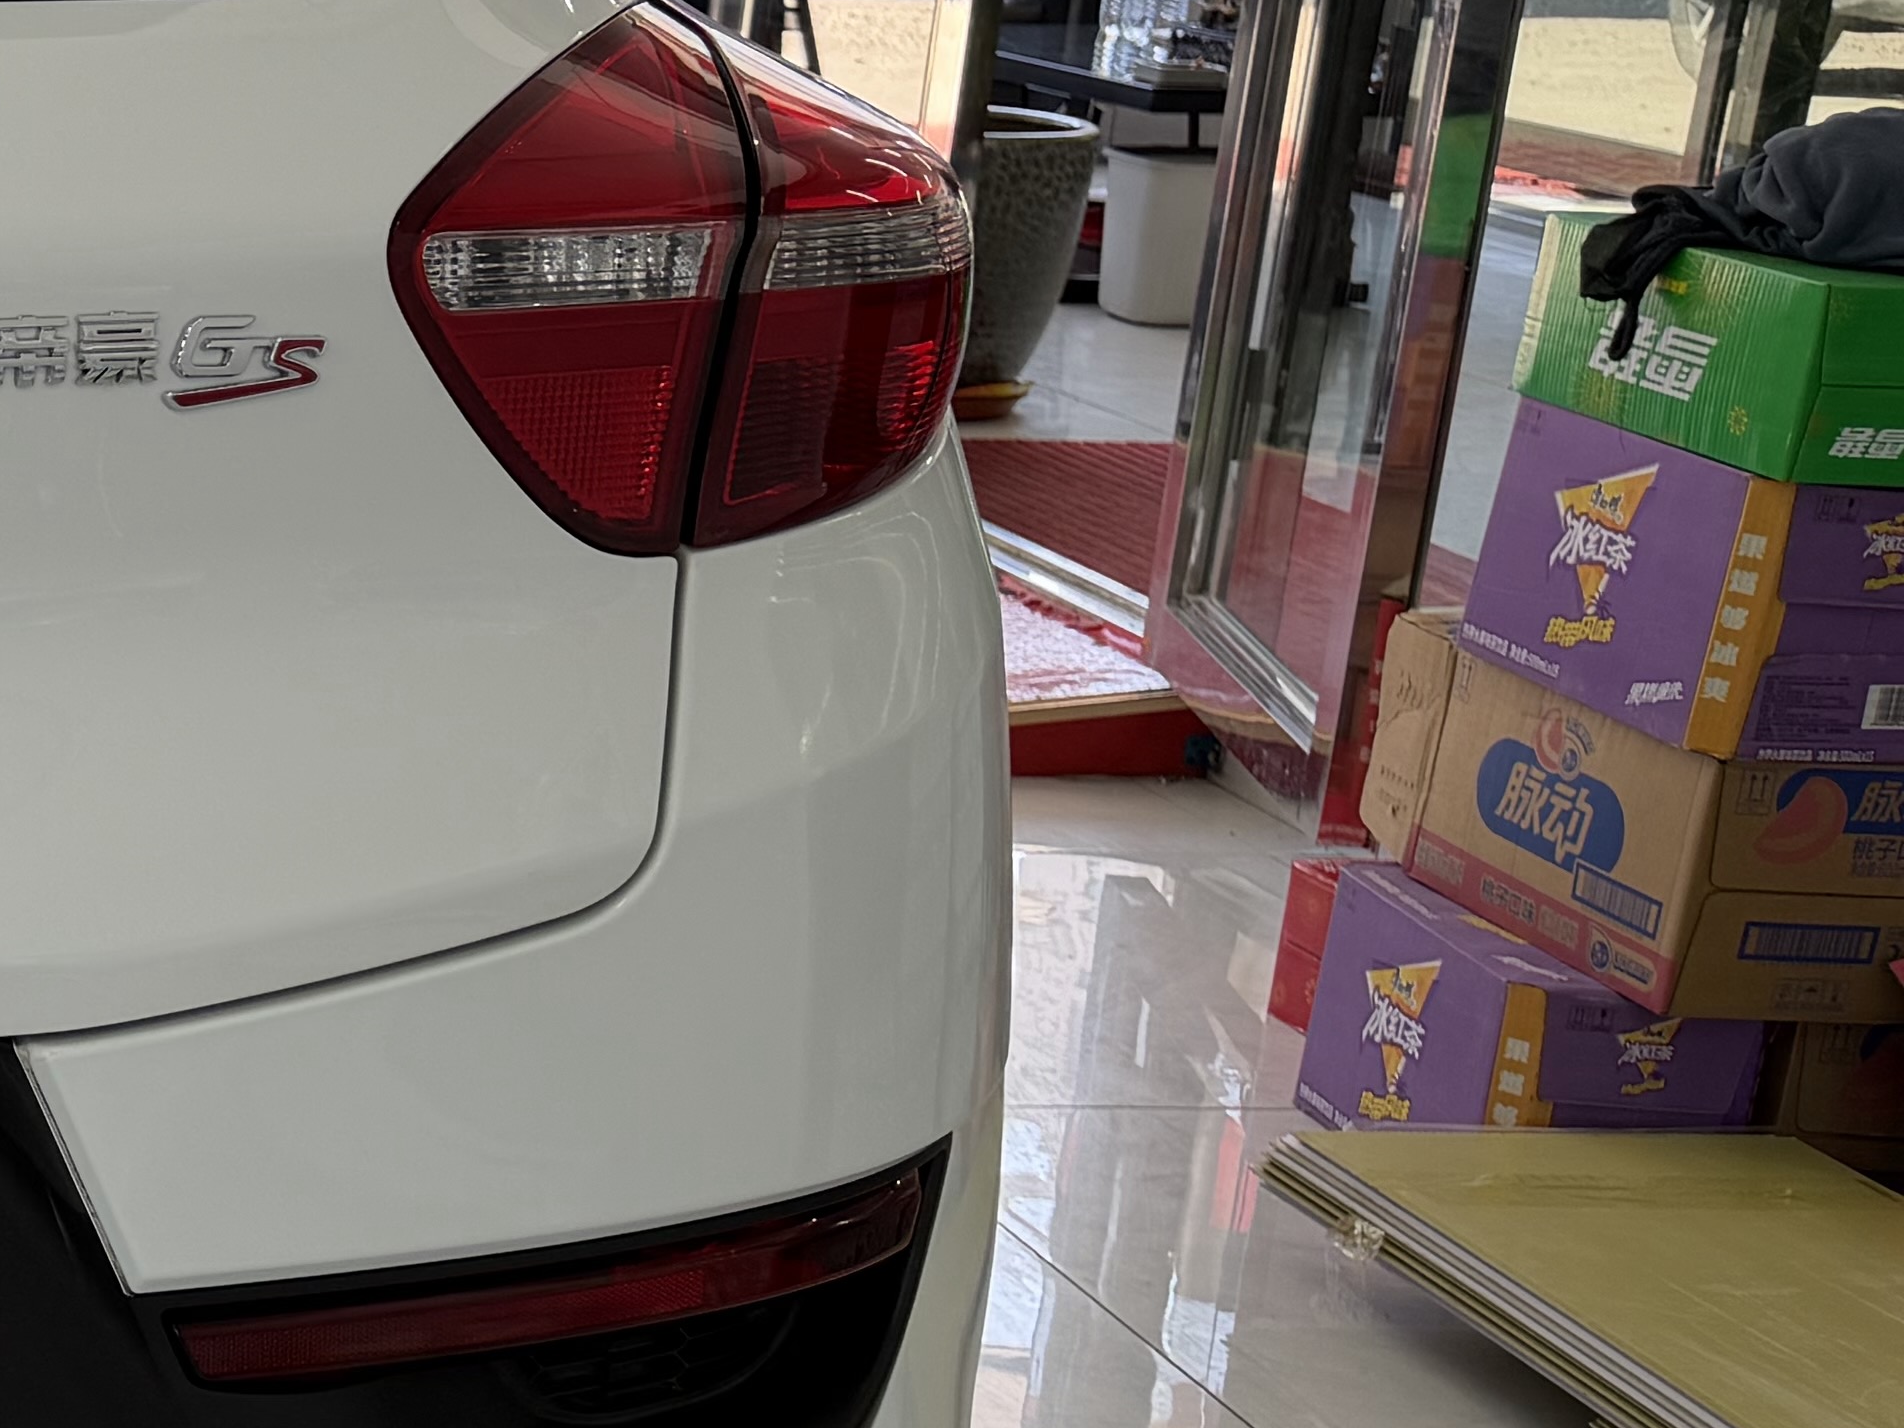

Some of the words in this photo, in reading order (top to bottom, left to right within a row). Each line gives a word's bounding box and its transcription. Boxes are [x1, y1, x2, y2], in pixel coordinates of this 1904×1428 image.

[1549, 508, 1636, 576] 冰红茶
[1495, 761, 1594, 864] 脉动
[1481, 874, 1537, 926] 桃子口味
[1361, 990, 1427, 1061] 冰红茶
